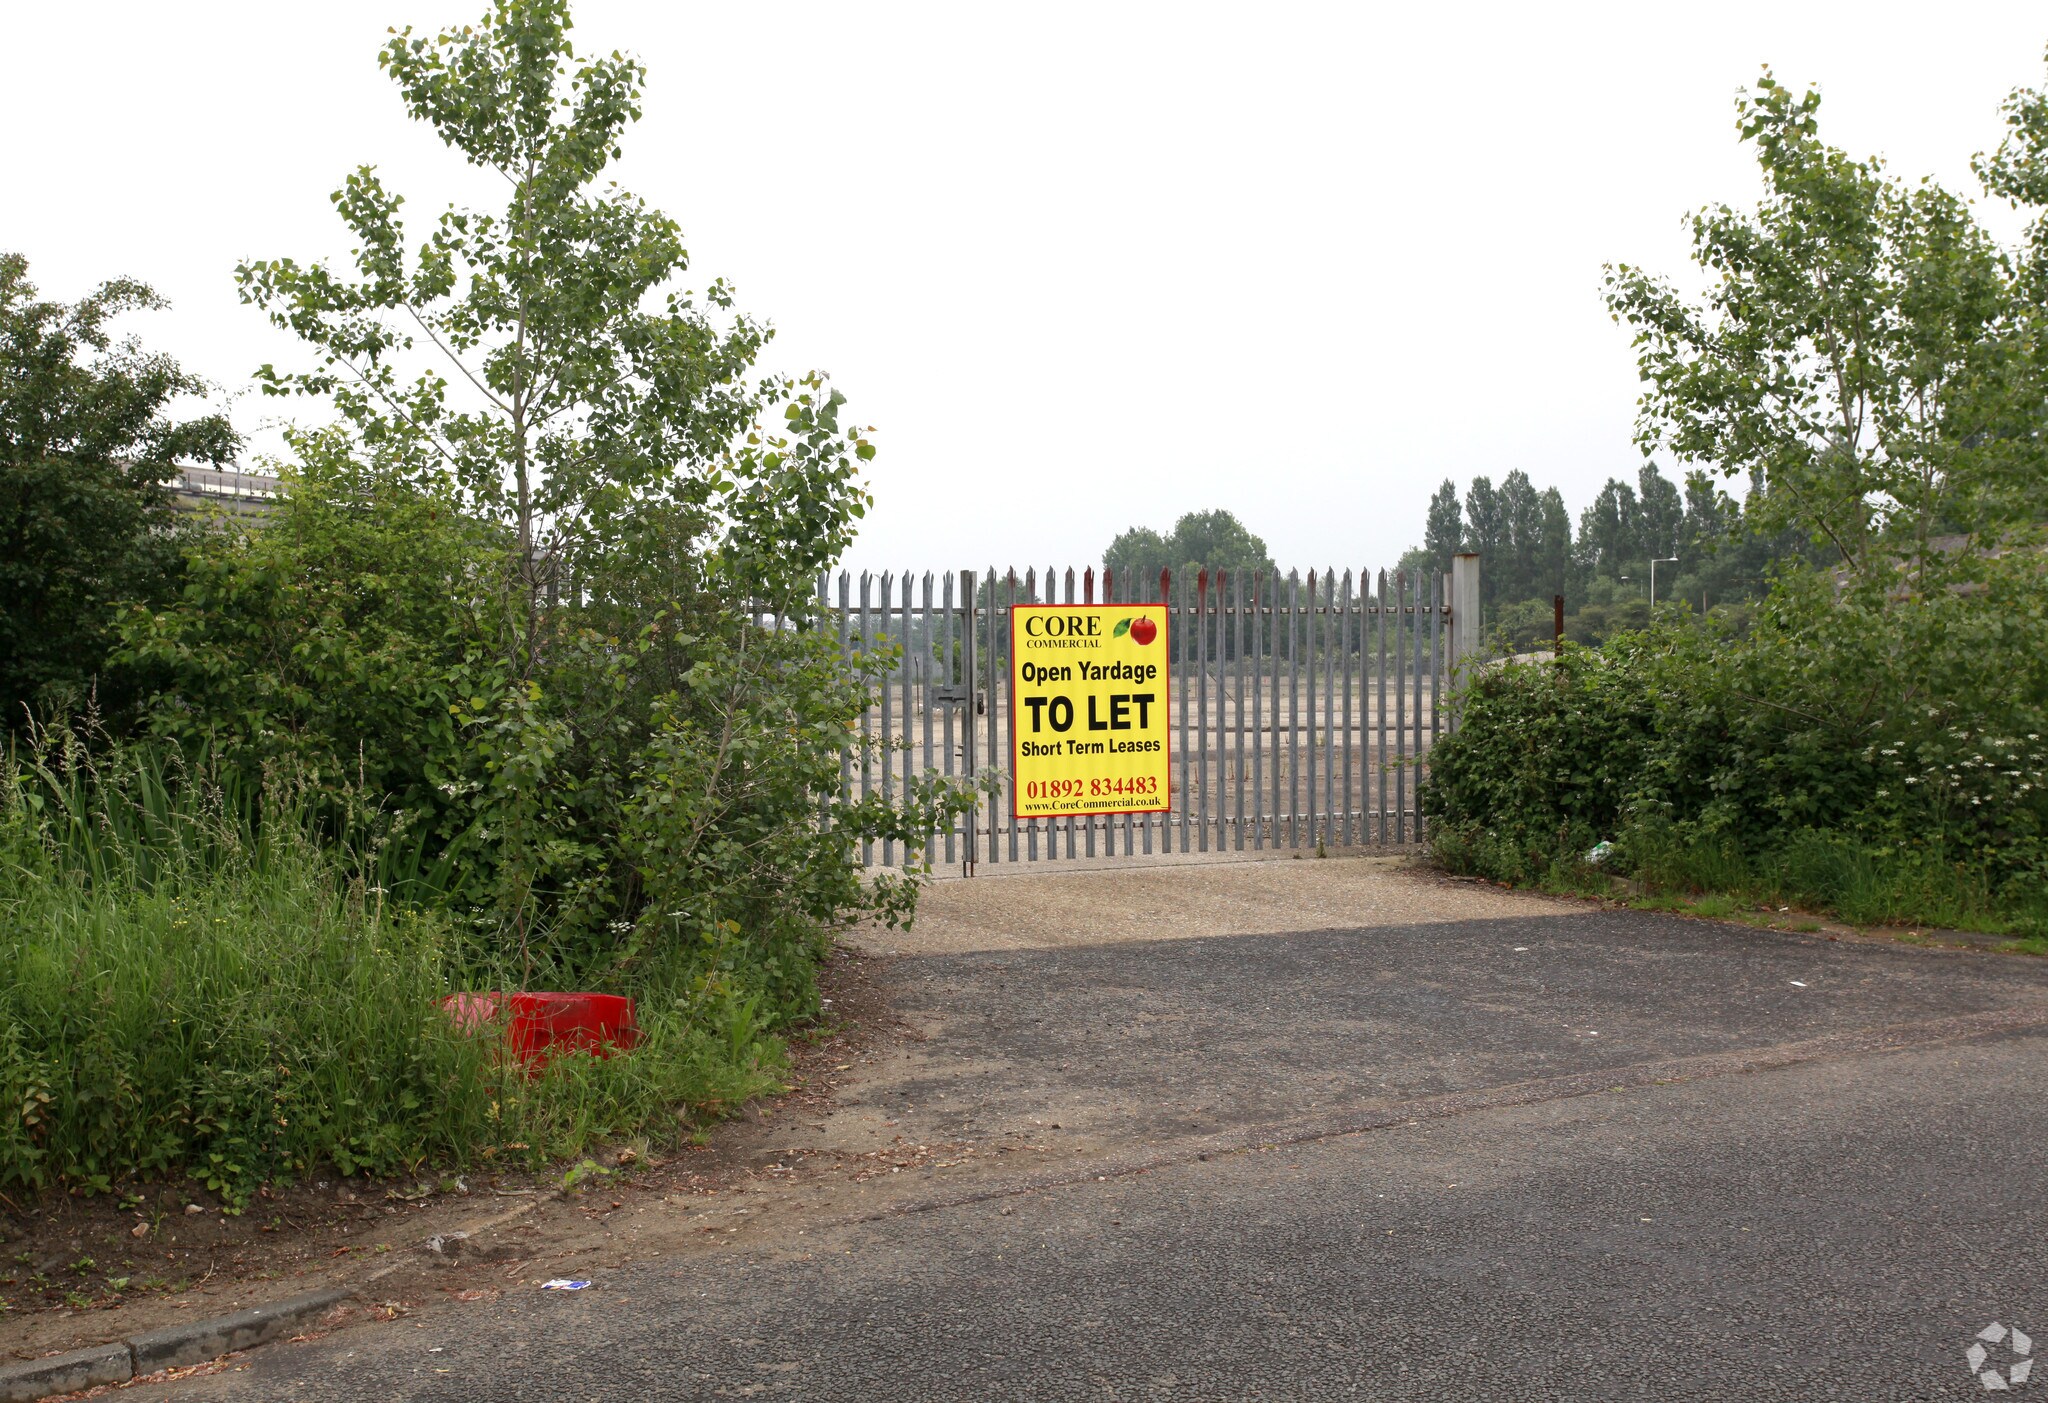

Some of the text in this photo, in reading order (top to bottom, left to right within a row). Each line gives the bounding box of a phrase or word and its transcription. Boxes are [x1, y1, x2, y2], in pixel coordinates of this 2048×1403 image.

[1026, 616, 1101, 636] CORE
[1027, 640, 1101, 648] COMMERCIAL
[1022, 661, 1156, 686] Open Yardage
[1025, 694, 1154, 732] TO LET
[1022, 738, 1160, 756] Short Term Leases
[1027, 776, 1157, 798] 01892 834483
[1025, 797, 1161, 811] www.CoreCommercial.co.uk
